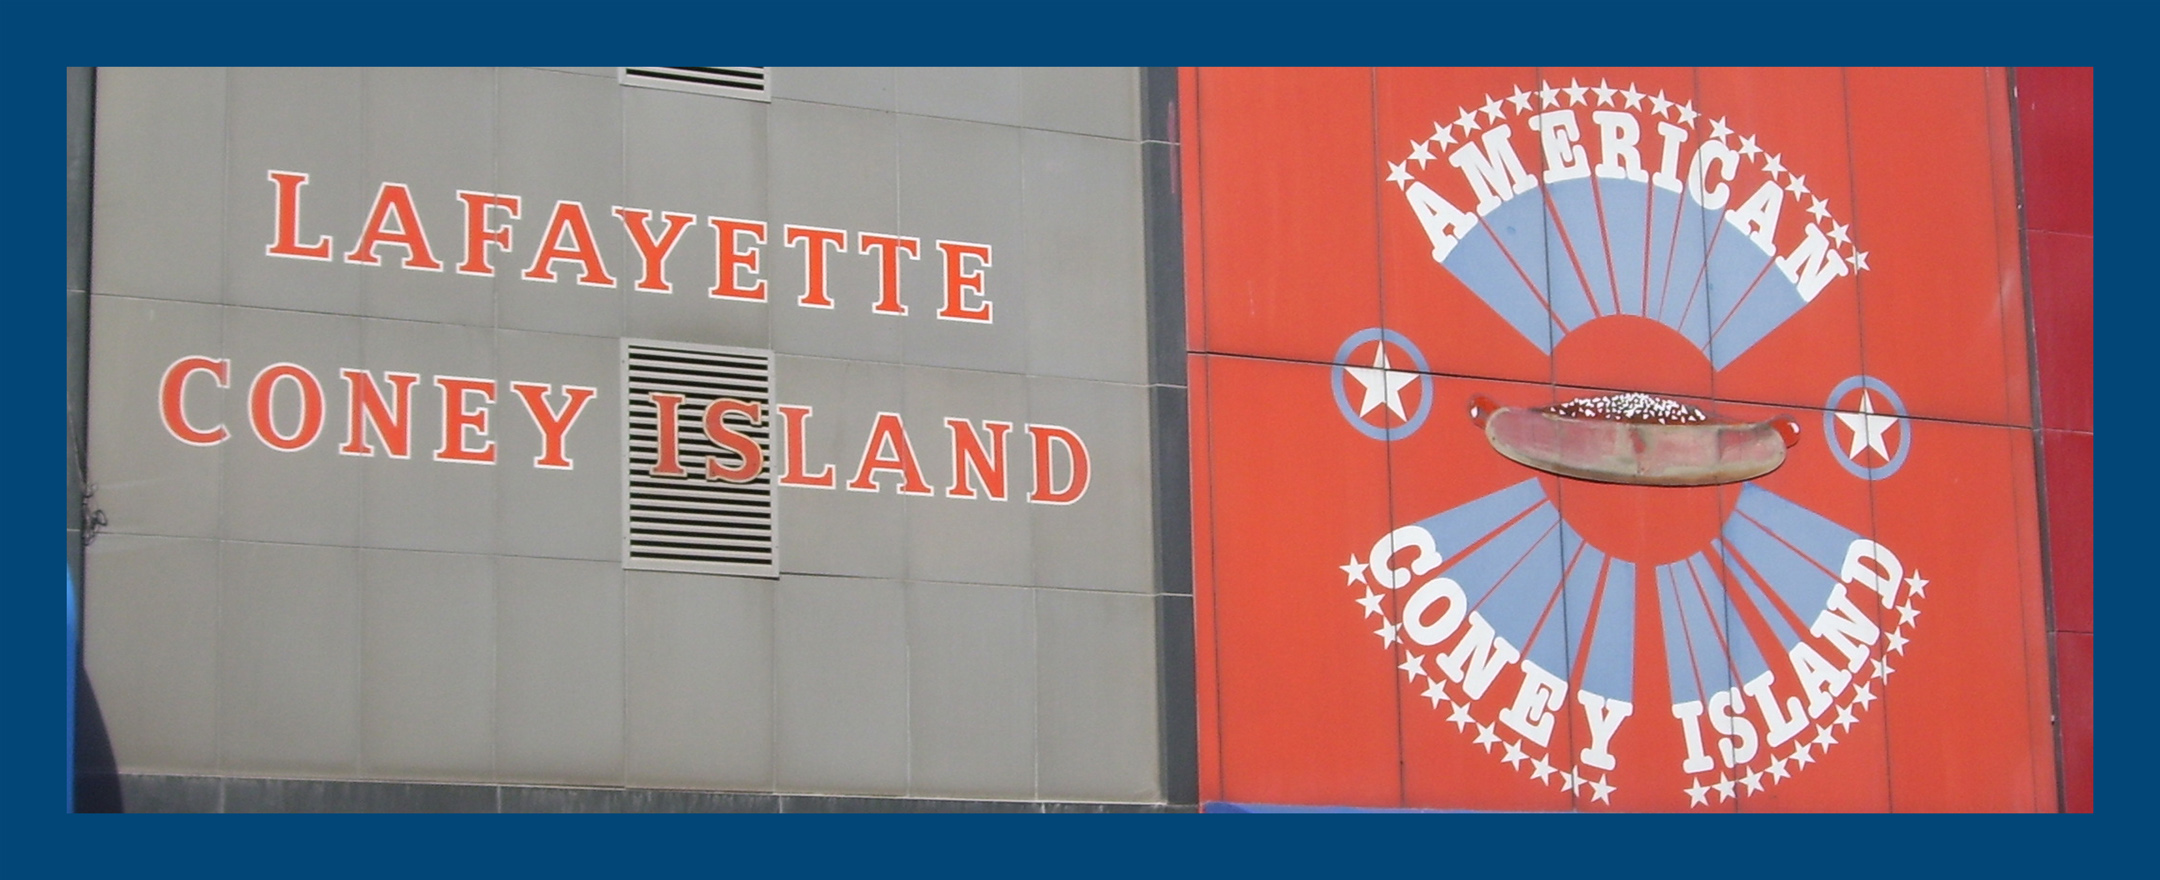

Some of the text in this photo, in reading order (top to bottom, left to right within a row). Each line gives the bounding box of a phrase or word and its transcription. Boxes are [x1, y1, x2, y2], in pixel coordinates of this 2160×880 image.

[266, 169, 993, 324] LAFAYETTE
[1404, 109, 1849, 302] AMERICAN
[158, 355, 1092, 506] CONEY ISLAND
[1368, 525, 1903, 773] CONEY ISLAND
